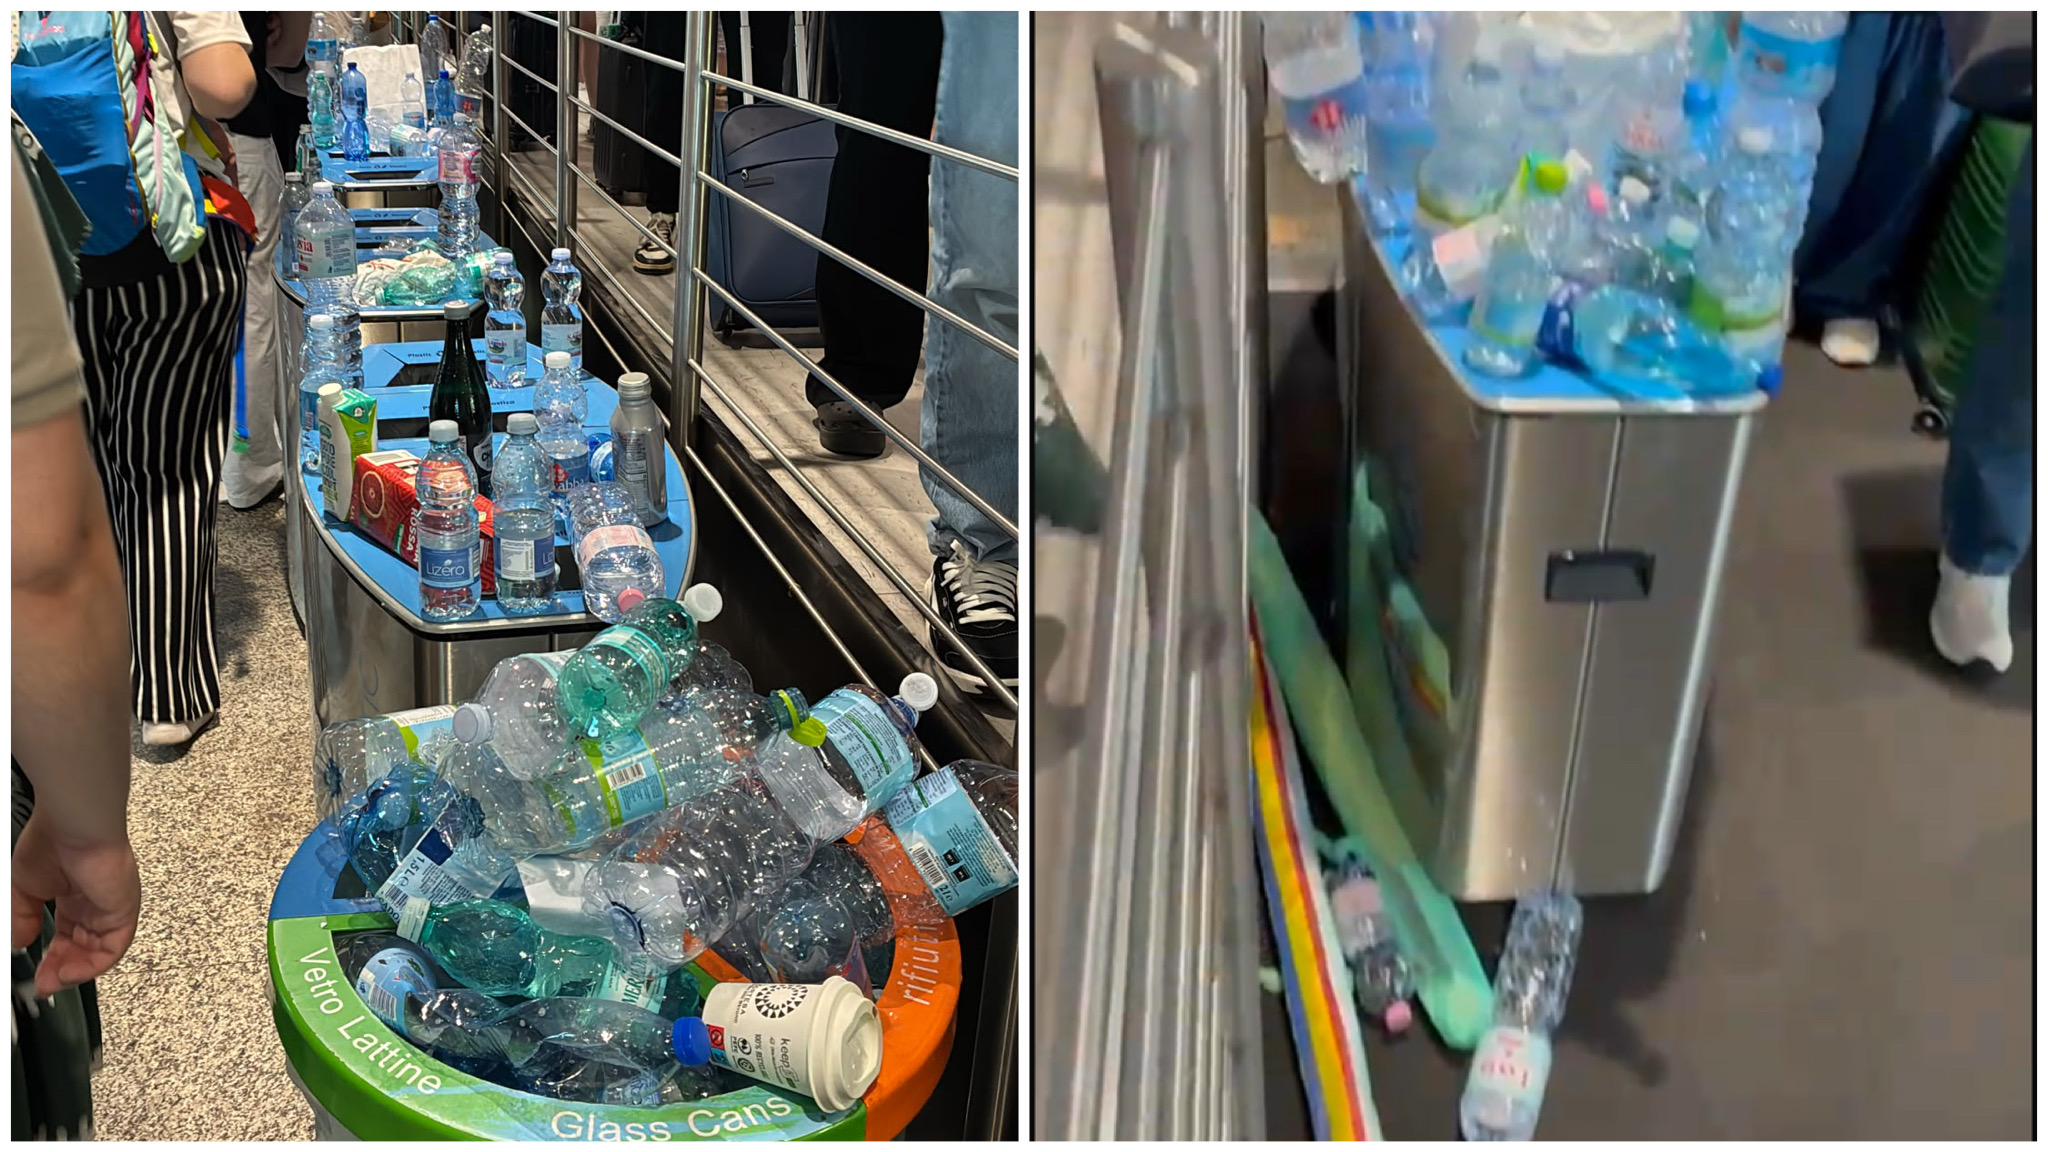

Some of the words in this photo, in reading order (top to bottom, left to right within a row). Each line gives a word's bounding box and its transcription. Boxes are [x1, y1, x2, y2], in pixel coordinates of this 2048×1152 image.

[379, 897, 401, 924] CADO
[898, 925, 940, 1005] rifiuti
[300, 947, 344, 1014] Vetro
[337, 1015, 442, 1094] Lattine
[780, 1038, 791, 1069] keep
[551, 1110, 672, 1141] Glass
[687, 1096, 792, 1138] Cans
